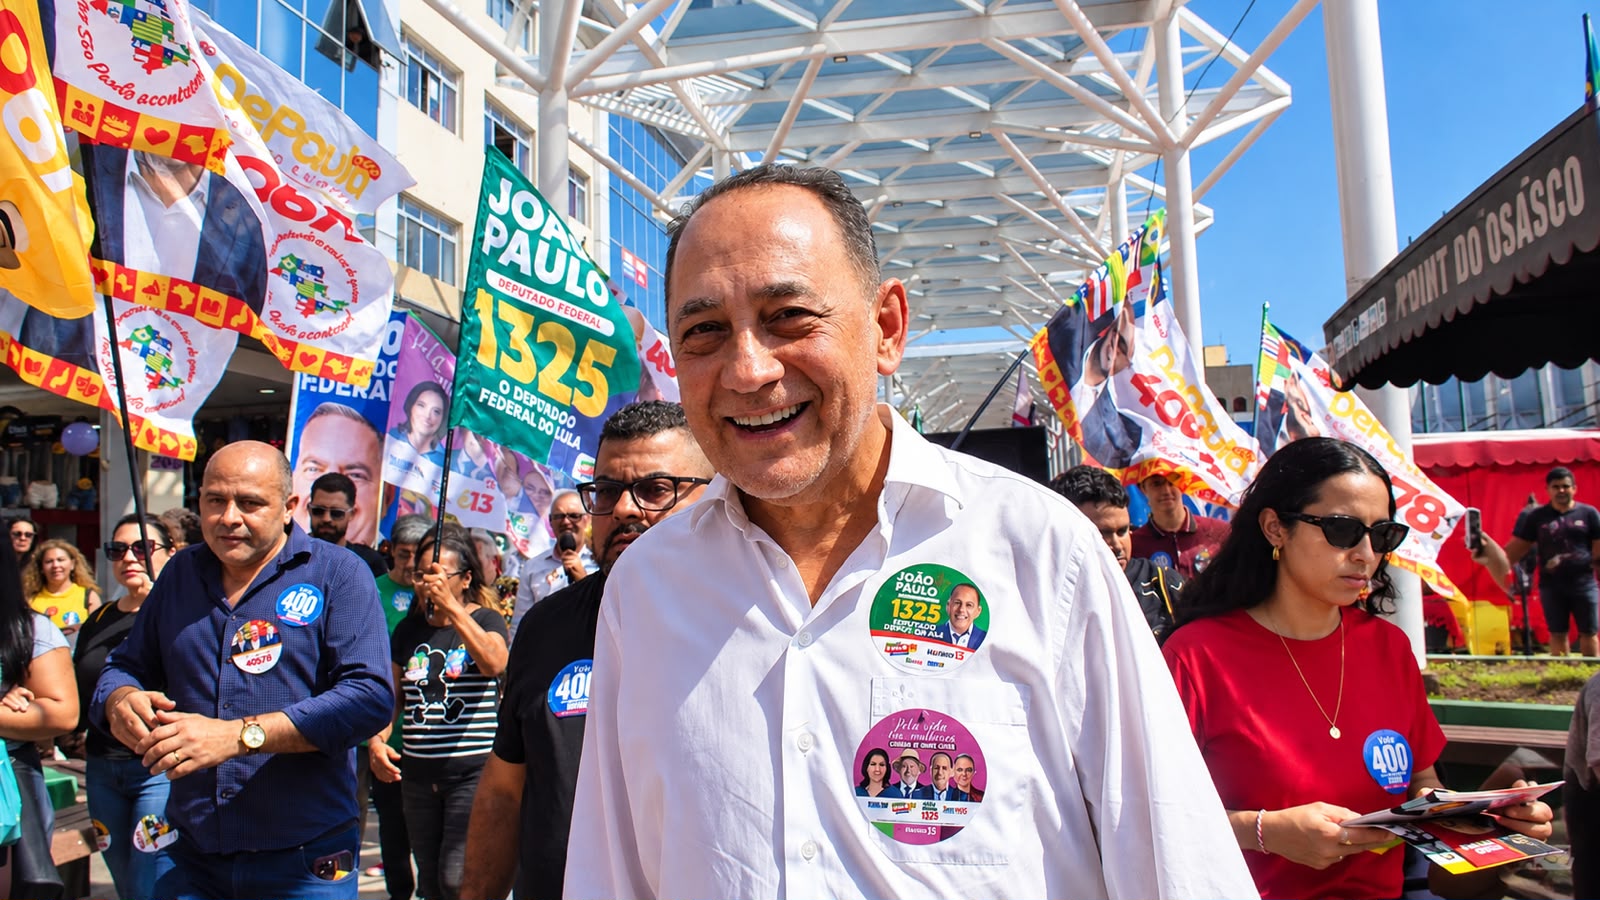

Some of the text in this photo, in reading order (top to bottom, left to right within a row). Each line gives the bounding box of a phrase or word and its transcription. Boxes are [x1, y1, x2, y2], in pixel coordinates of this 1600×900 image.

[482, 213, 609, 307] PAULO
[1453, 226, 1484, 285] DO
[498, 278, 601, 328] DEPUTADO FEDERAL
[474, 288, 617, 418] 1325
[499, 380, 511, 394] O
[478, 387, 581, 450] FEDERAL DO LULA
[895, 582, 938, 597] PAULO
[896, 571, 934, 586] JOÃO
[281, 591, 318, 617] 400
[891, 598, 941, 623] 1325
[1373, 743, 1408, 773] 400
